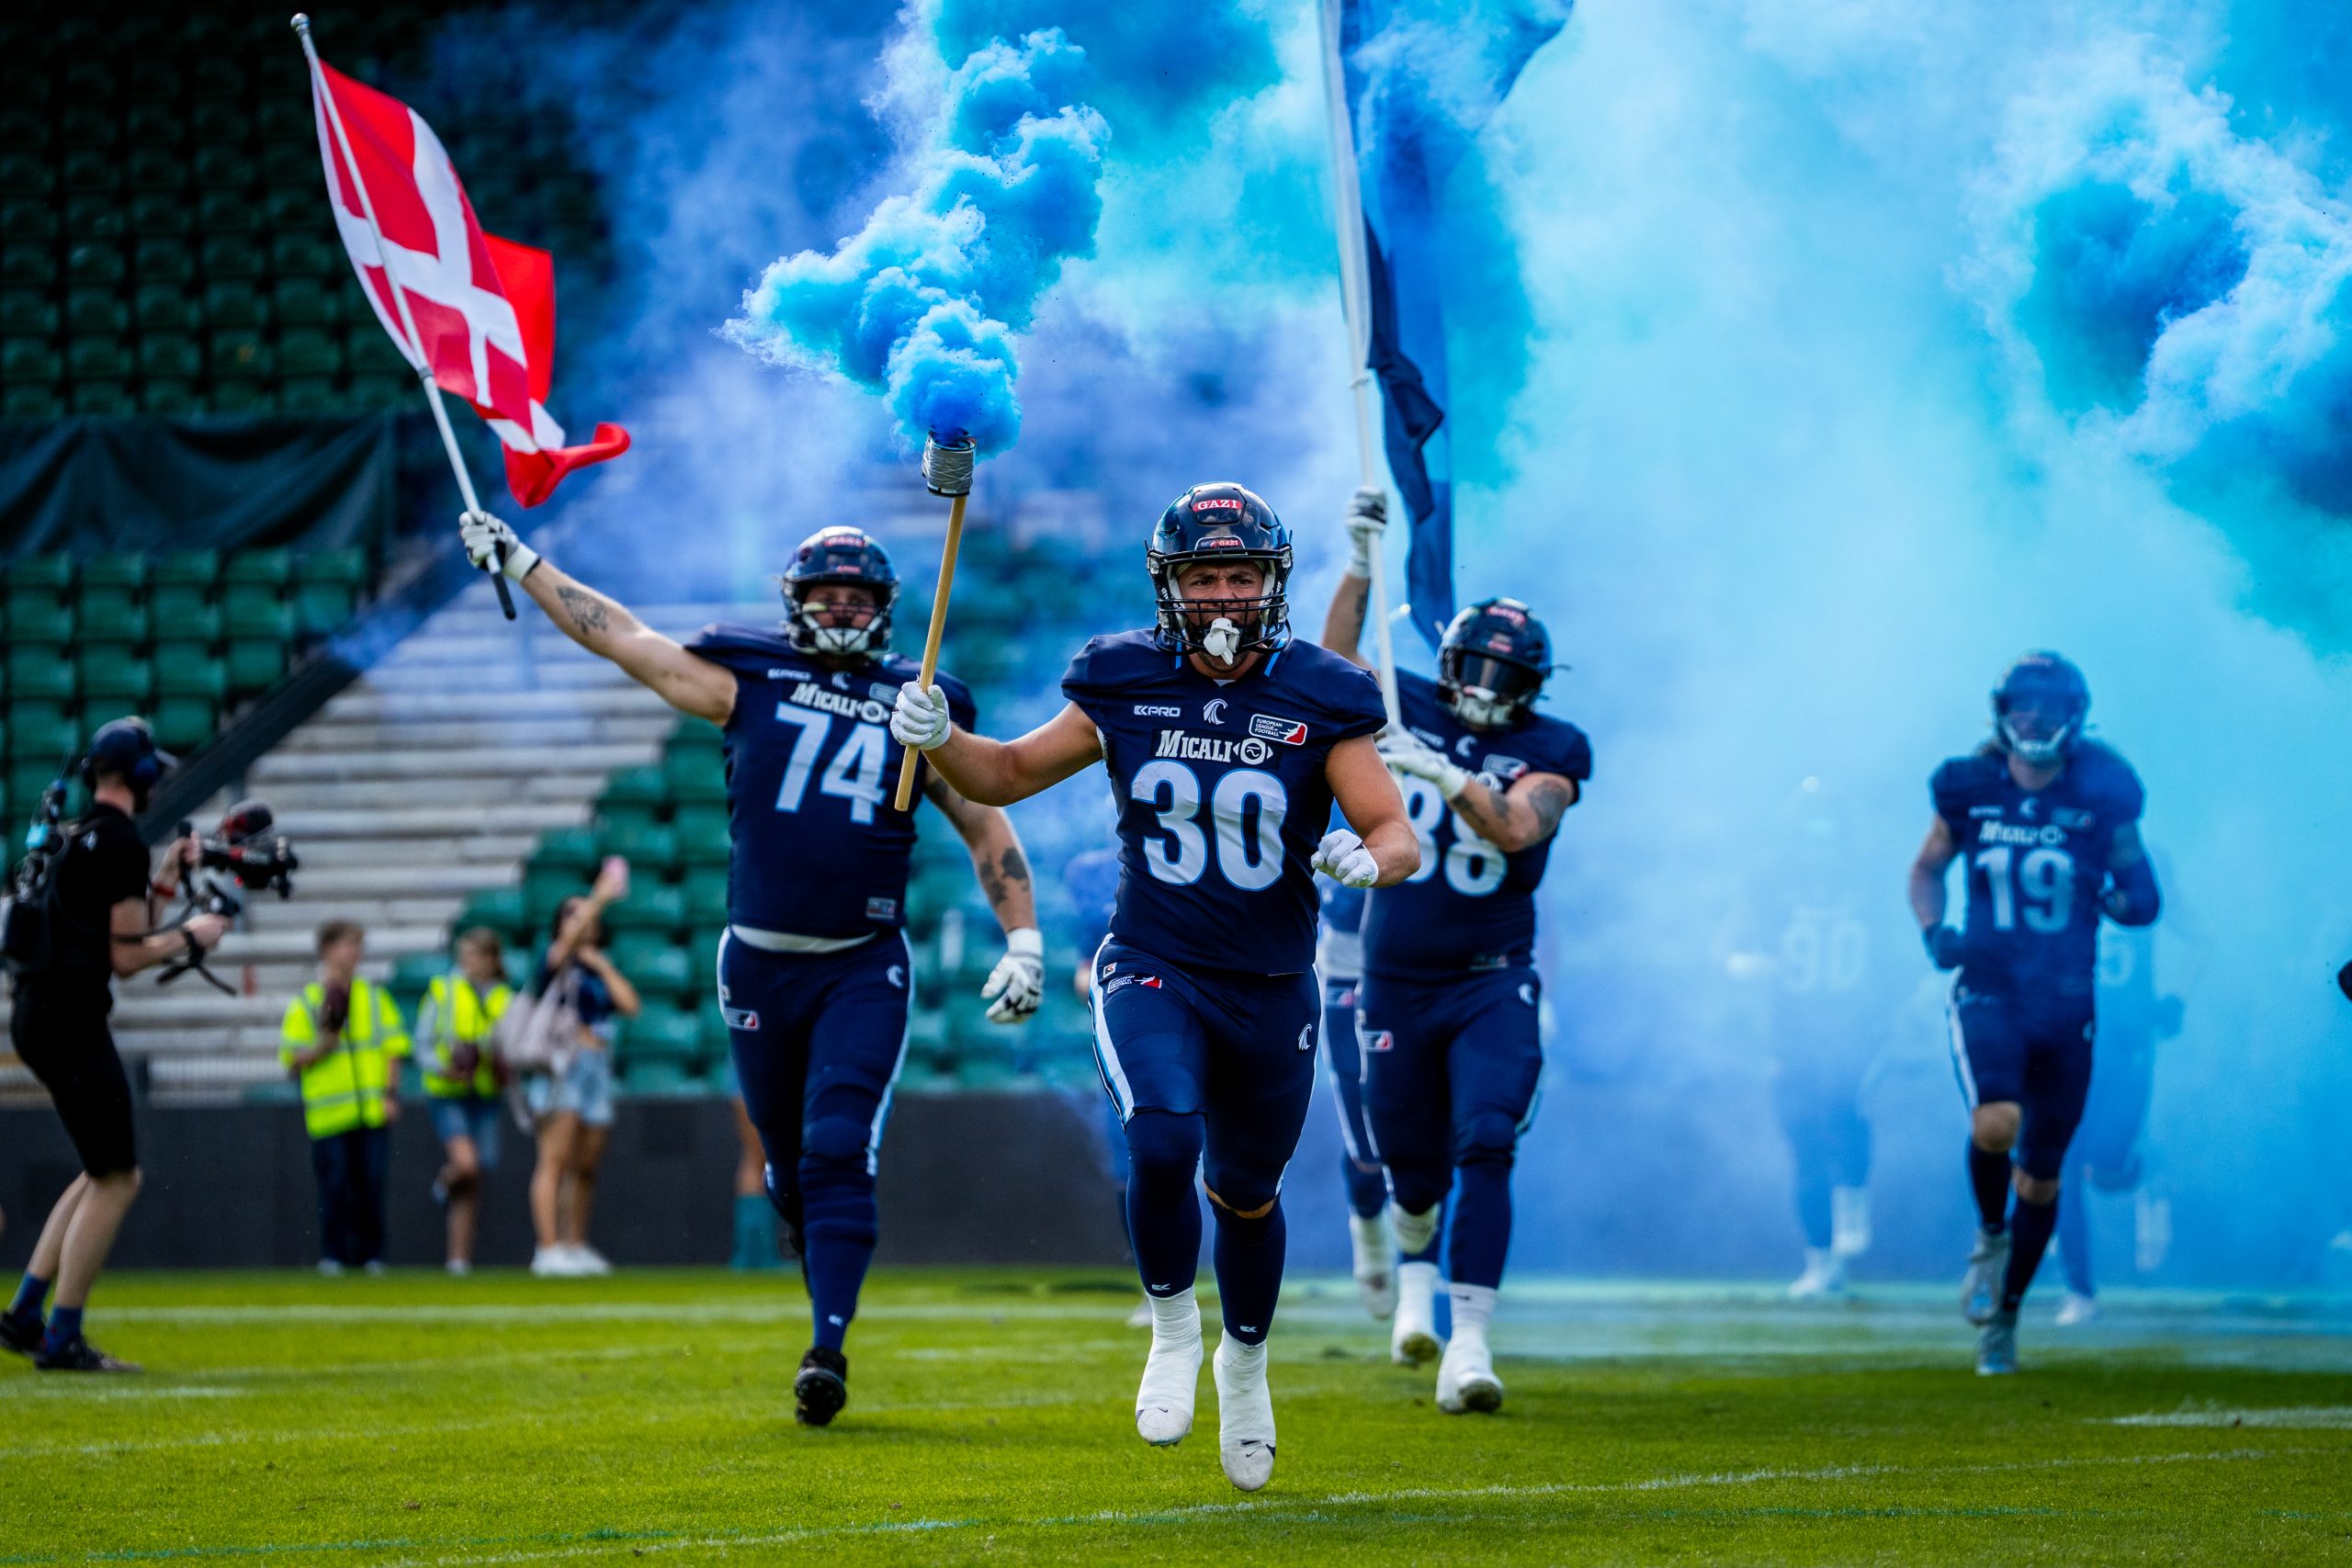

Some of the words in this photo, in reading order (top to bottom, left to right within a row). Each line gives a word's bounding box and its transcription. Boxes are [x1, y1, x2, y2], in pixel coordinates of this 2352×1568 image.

[1197, 499, 1238, 511] GAZI
[1255, 728, 1279, 737] FOOTBALL
[1257, 718, 1283, 728] EUROPEAN
[775, 702, 889, 824] 74
[1131, 760, 1287, 892] 30
[1973, 845, 2077, 934] 19
